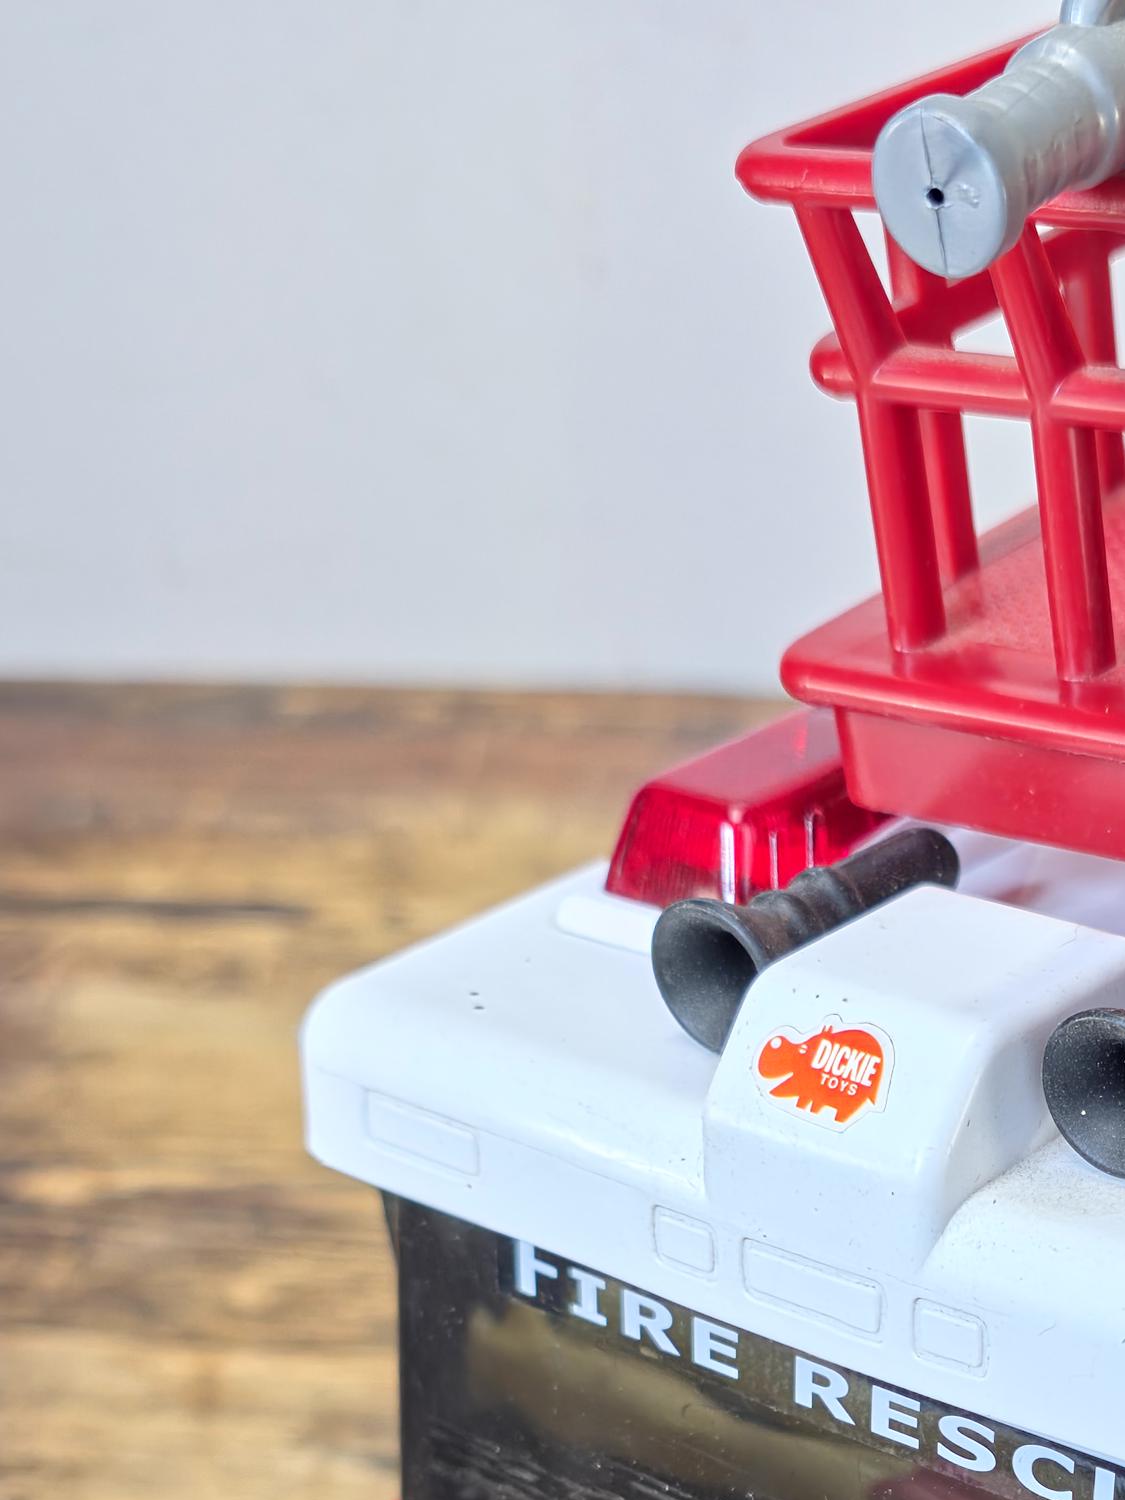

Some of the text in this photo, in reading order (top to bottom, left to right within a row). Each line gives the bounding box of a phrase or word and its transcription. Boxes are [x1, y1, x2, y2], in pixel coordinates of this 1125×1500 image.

[811, 1039, 881, 1087] DICKIE
[820, 1072, 858, 1096] TOYS
[513, 1238, 739, 1380] FIRE
